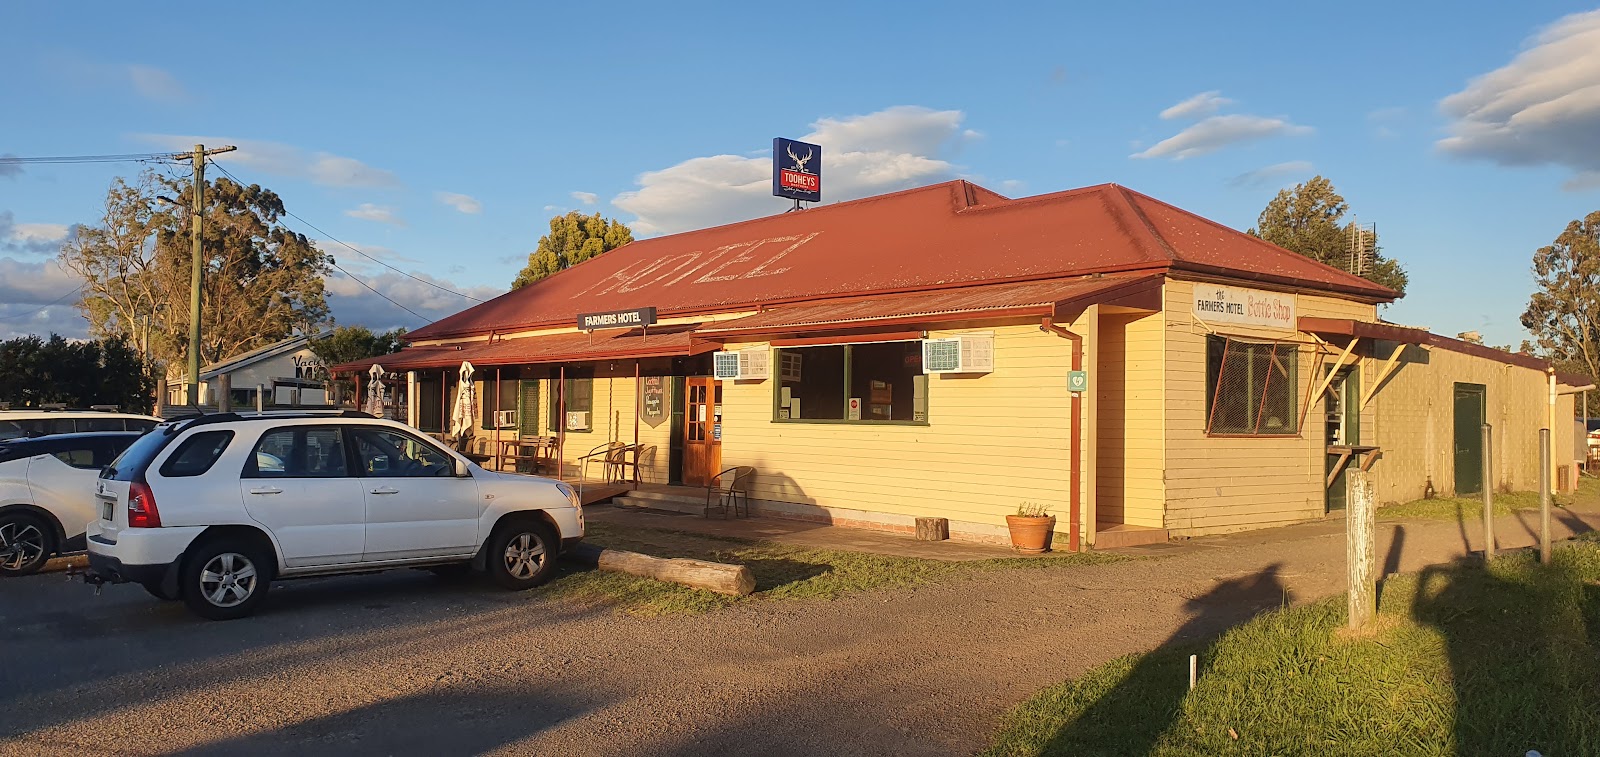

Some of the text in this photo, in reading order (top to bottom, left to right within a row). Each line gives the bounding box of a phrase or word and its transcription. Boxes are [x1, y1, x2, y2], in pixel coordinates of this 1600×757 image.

[785, 173, 815, 186] TOOHEYS
[569, 231, 824, 299] HOTEL
[1197, 300, 1244, 315] FARMERS HOTEL
[1247, 295, 1291, 323] Bottle Shop
[585, 312, 641, 326] FARMERS HOTEL
[292, 355, 321, 372] Vacy
